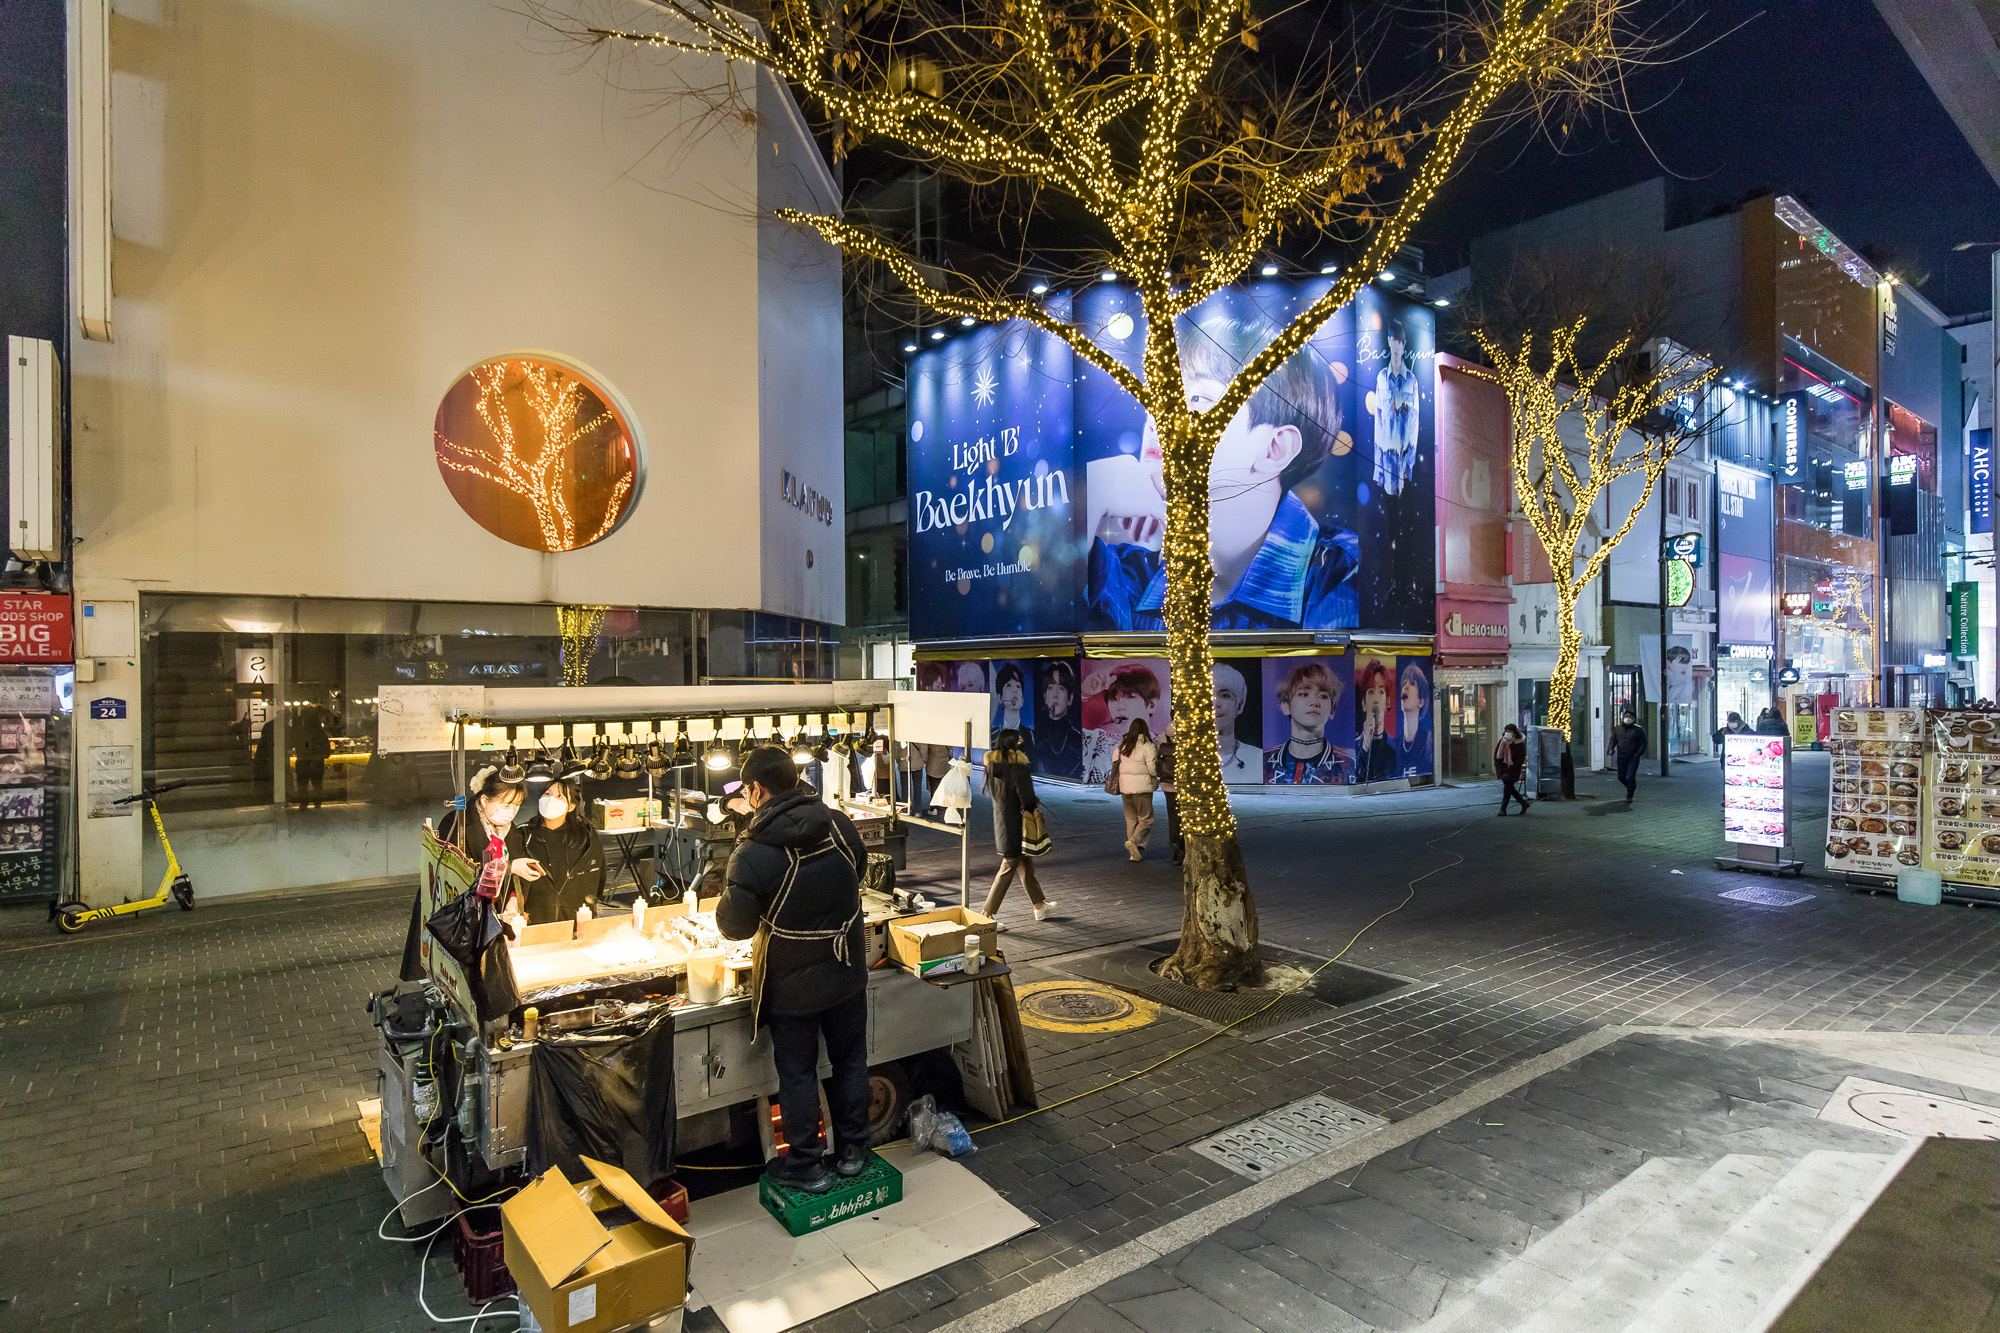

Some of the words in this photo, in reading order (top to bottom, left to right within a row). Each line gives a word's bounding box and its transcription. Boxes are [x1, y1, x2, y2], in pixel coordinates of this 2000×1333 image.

[1786, 398, 1798, 464] CONVERSE
[953, 436, 996, 475] Light
[1974, 447, 1989, 481] AHC
[916, 470, 1070, 533] Baekhyun
[945, 569, 956, 582] Be
[958, 567, 981, 581] Brave,
[984, 564, 995, 577] Be
[4, 600, 43, 610] STAR
[1961, 592, 1969, 616] Nature
[30, 612, 64, 622] SHOP
[0, 624, 50, 642] BIG
[1961, 617, 1969, 654] Collection
[0, 644, 50, 656] SALE
[1730, 645, 1768, 659] CONVERSE
[101, 708, 117, 717] 24
